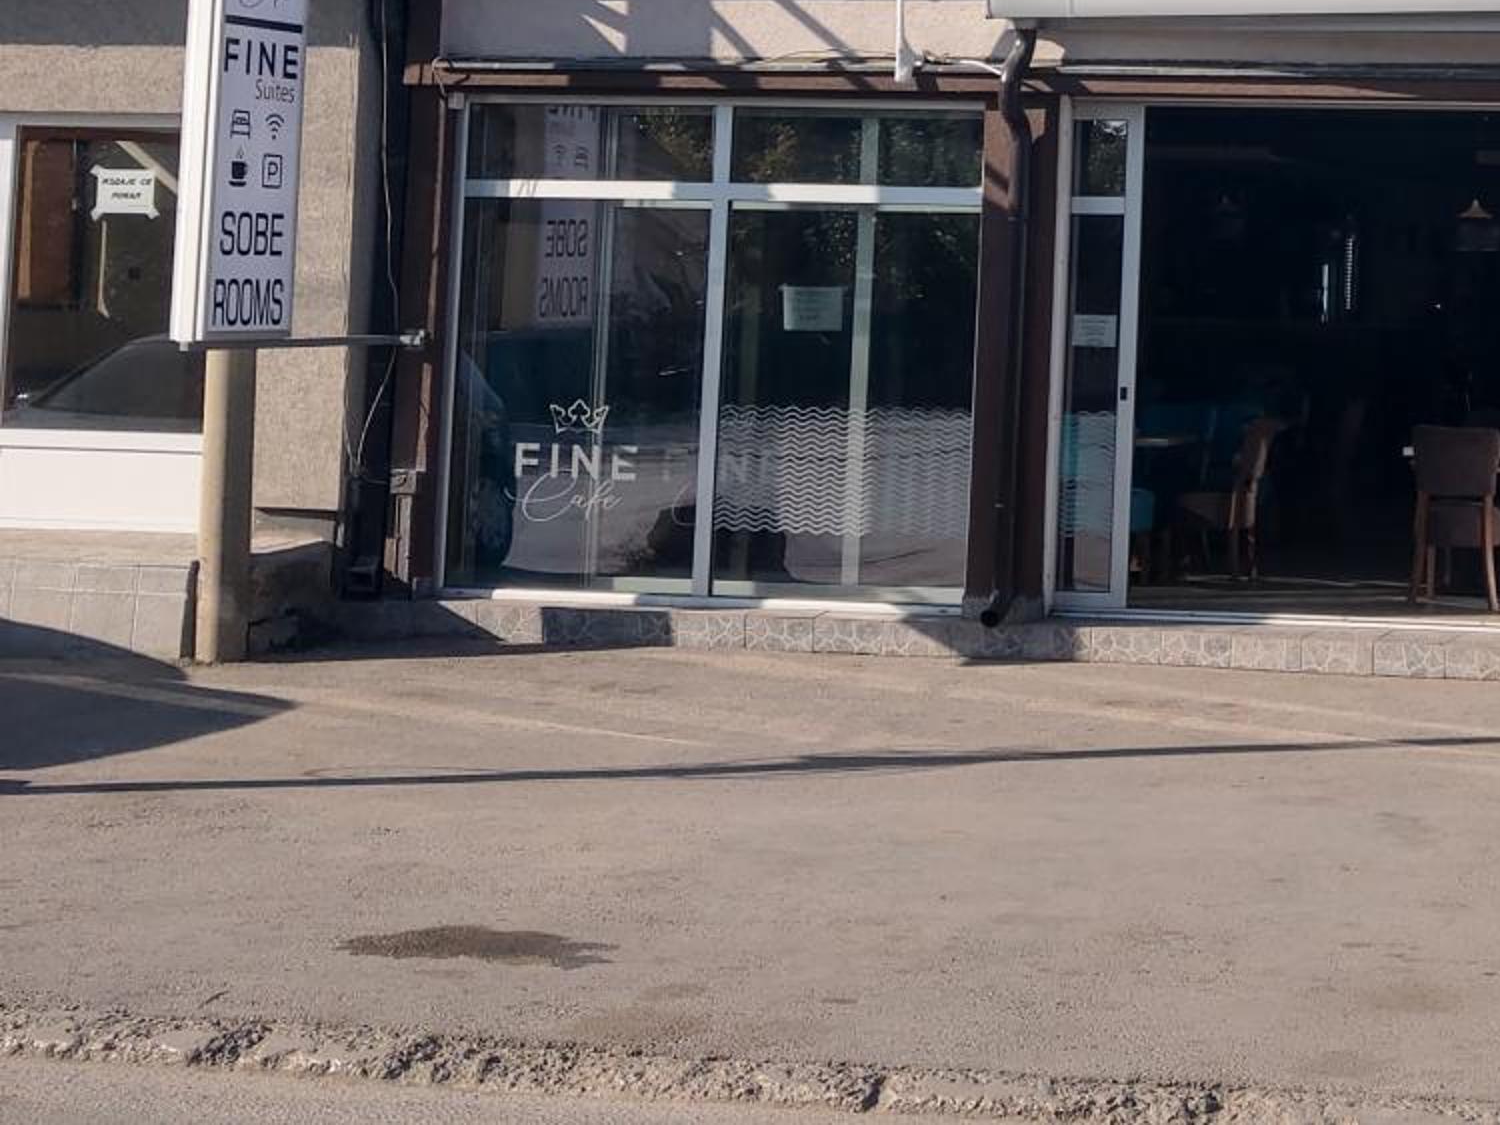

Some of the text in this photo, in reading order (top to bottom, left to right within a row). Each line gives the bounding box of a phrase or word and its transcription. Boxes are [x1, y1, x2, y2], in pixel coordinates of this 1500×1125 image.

[224, 36, 299, 80] FINE
[255, 78, 295, 103] Suites
[220, 210, 285, 256] SOBE
[212, 278, 285, 326] ROOMS
[514, 442, 638, 481] FINE
